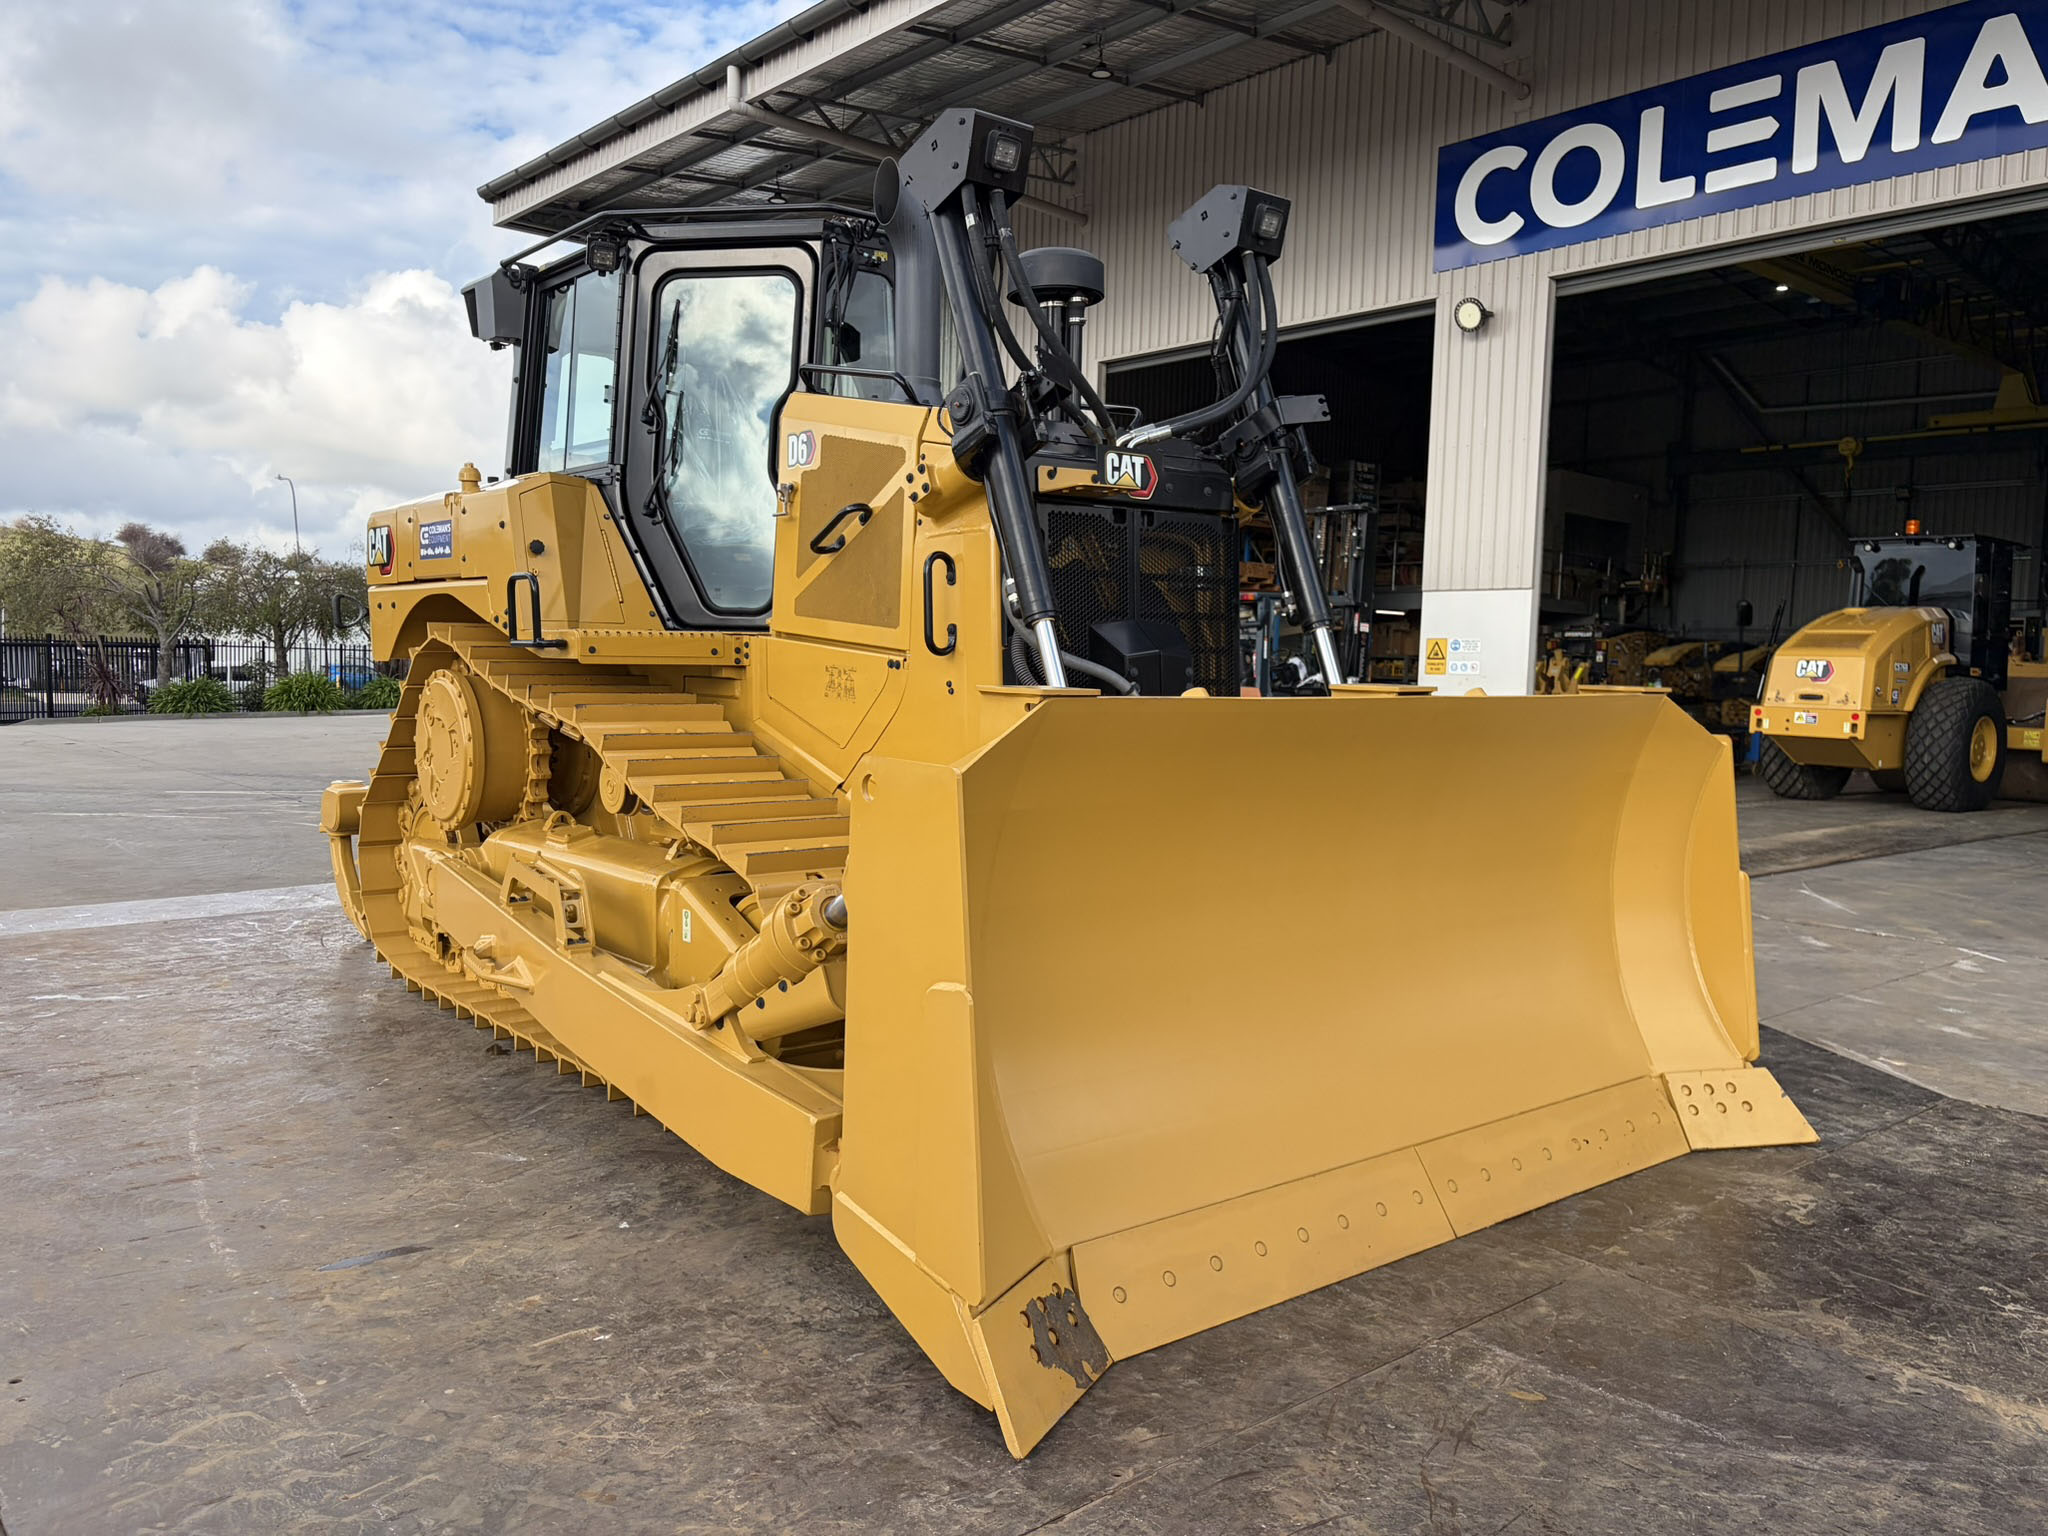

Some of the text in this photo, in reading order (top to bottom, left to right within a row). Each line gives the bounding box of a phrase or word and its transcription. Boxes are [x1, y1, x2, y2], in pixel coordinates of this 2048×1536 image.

[1454, 13, 2048, 246] COLEMA
[788, 432, 808, 467] D6
[1106, 452, 1145, 488] CAT
[368, 526, 389, 565] CAT
[1796, 659, 1828, 678] CAT
